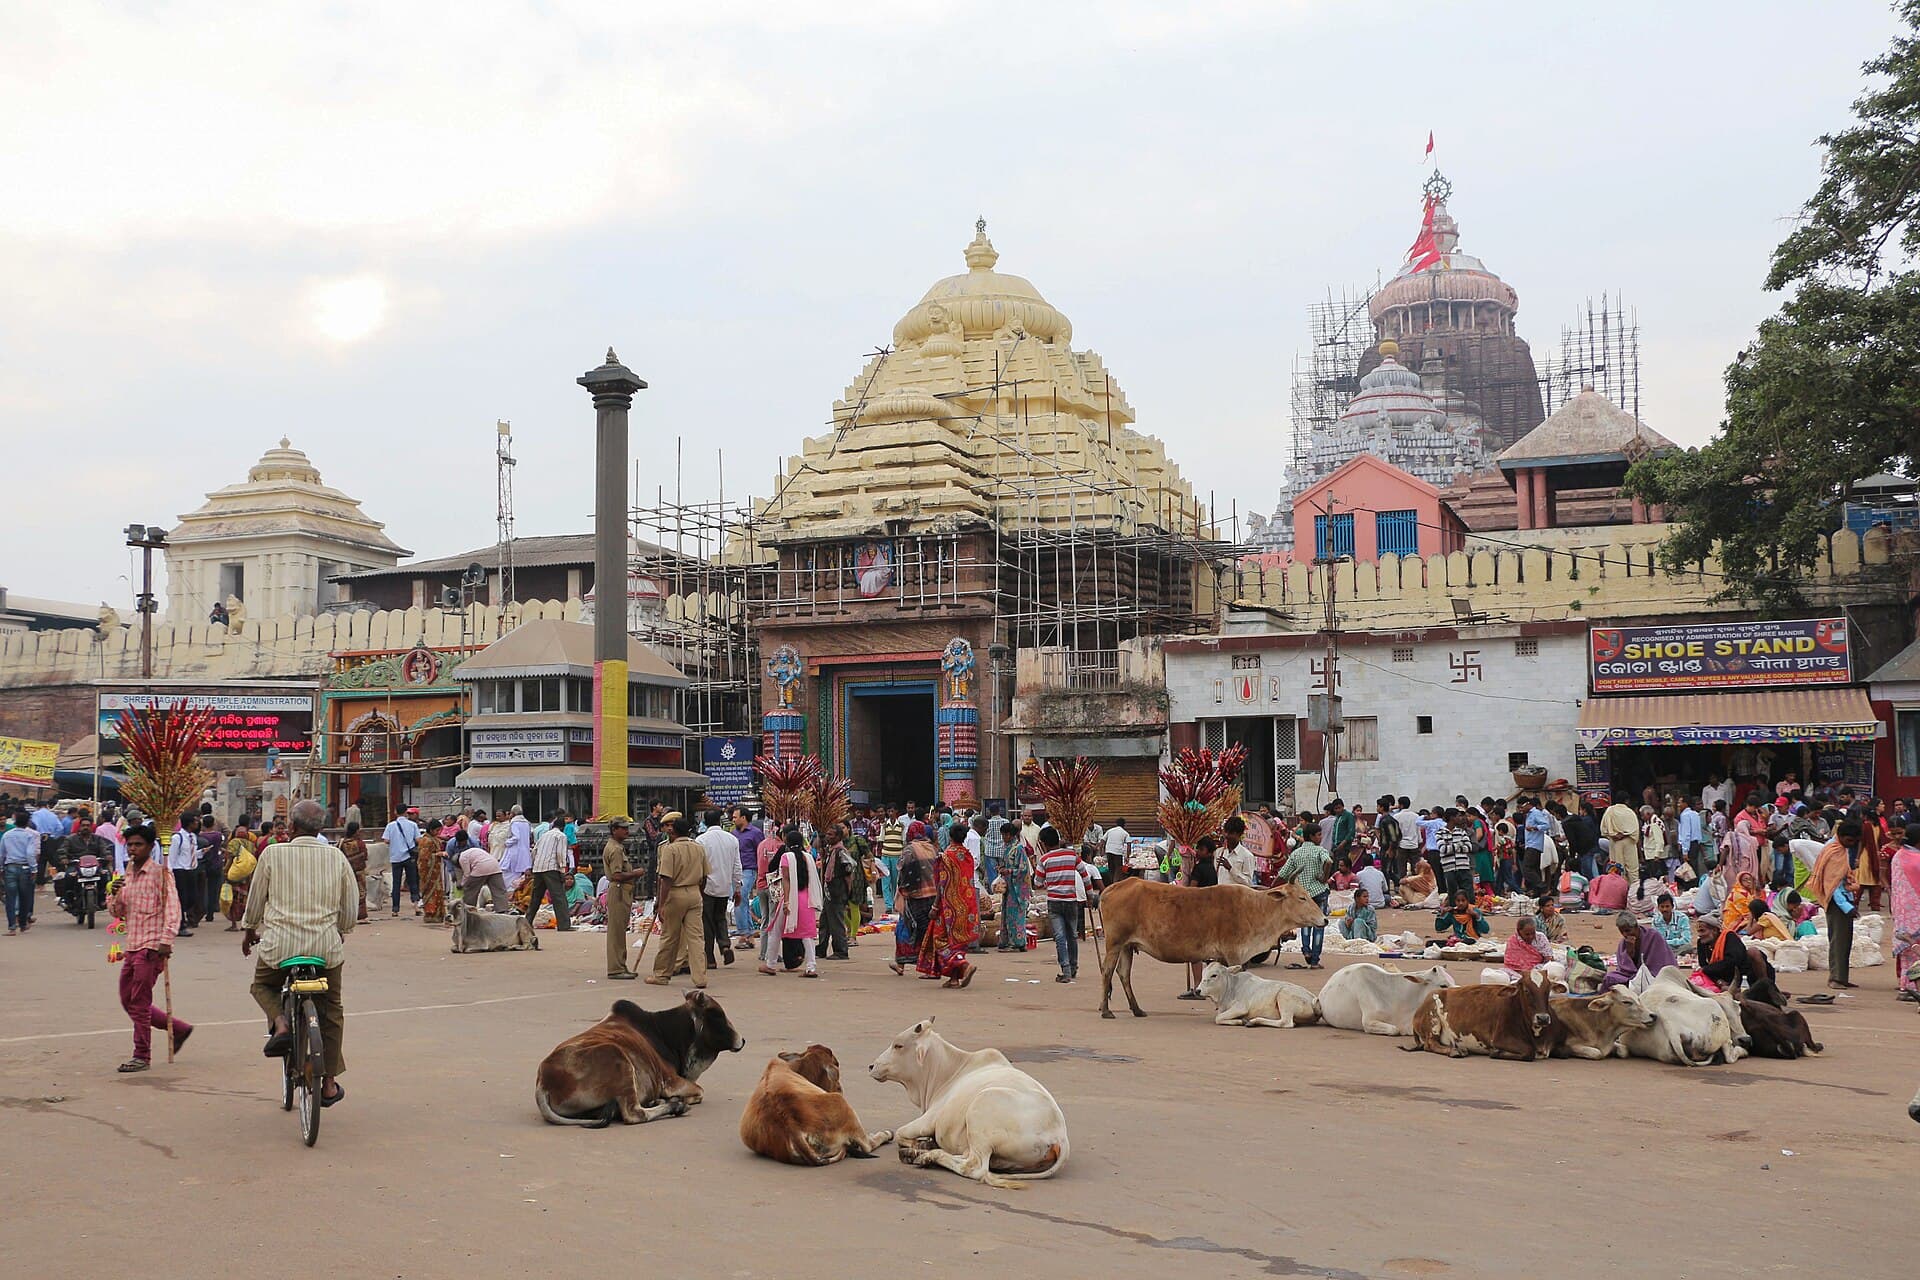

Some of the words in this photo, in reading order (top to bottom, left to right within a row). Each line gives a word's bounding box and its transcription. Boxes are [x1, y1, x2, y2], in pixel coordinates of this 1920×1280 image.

[1631, 635, 1674, 643] RECOGNISED
[1686, 632, 1741, 641] ADMINISTRATION
[1624, 640, 1705, 660] SHOE
[1714, 636, 1816, 656] STAND
[1598, 661, 1652, 674] ଜୋତା
[1748, 655, 1793, 670] जोता
[1741, 672, 1771, 680] VALUABLE
[123, 696, 151, 704] SHREE
[241, 697, 308, 705] ADMINISTRATION
[1678, 727, 1722, 738] जोता
[1777, 726, 1820, 737] SHOE
[1823, 725, 1875, 736] STAND
